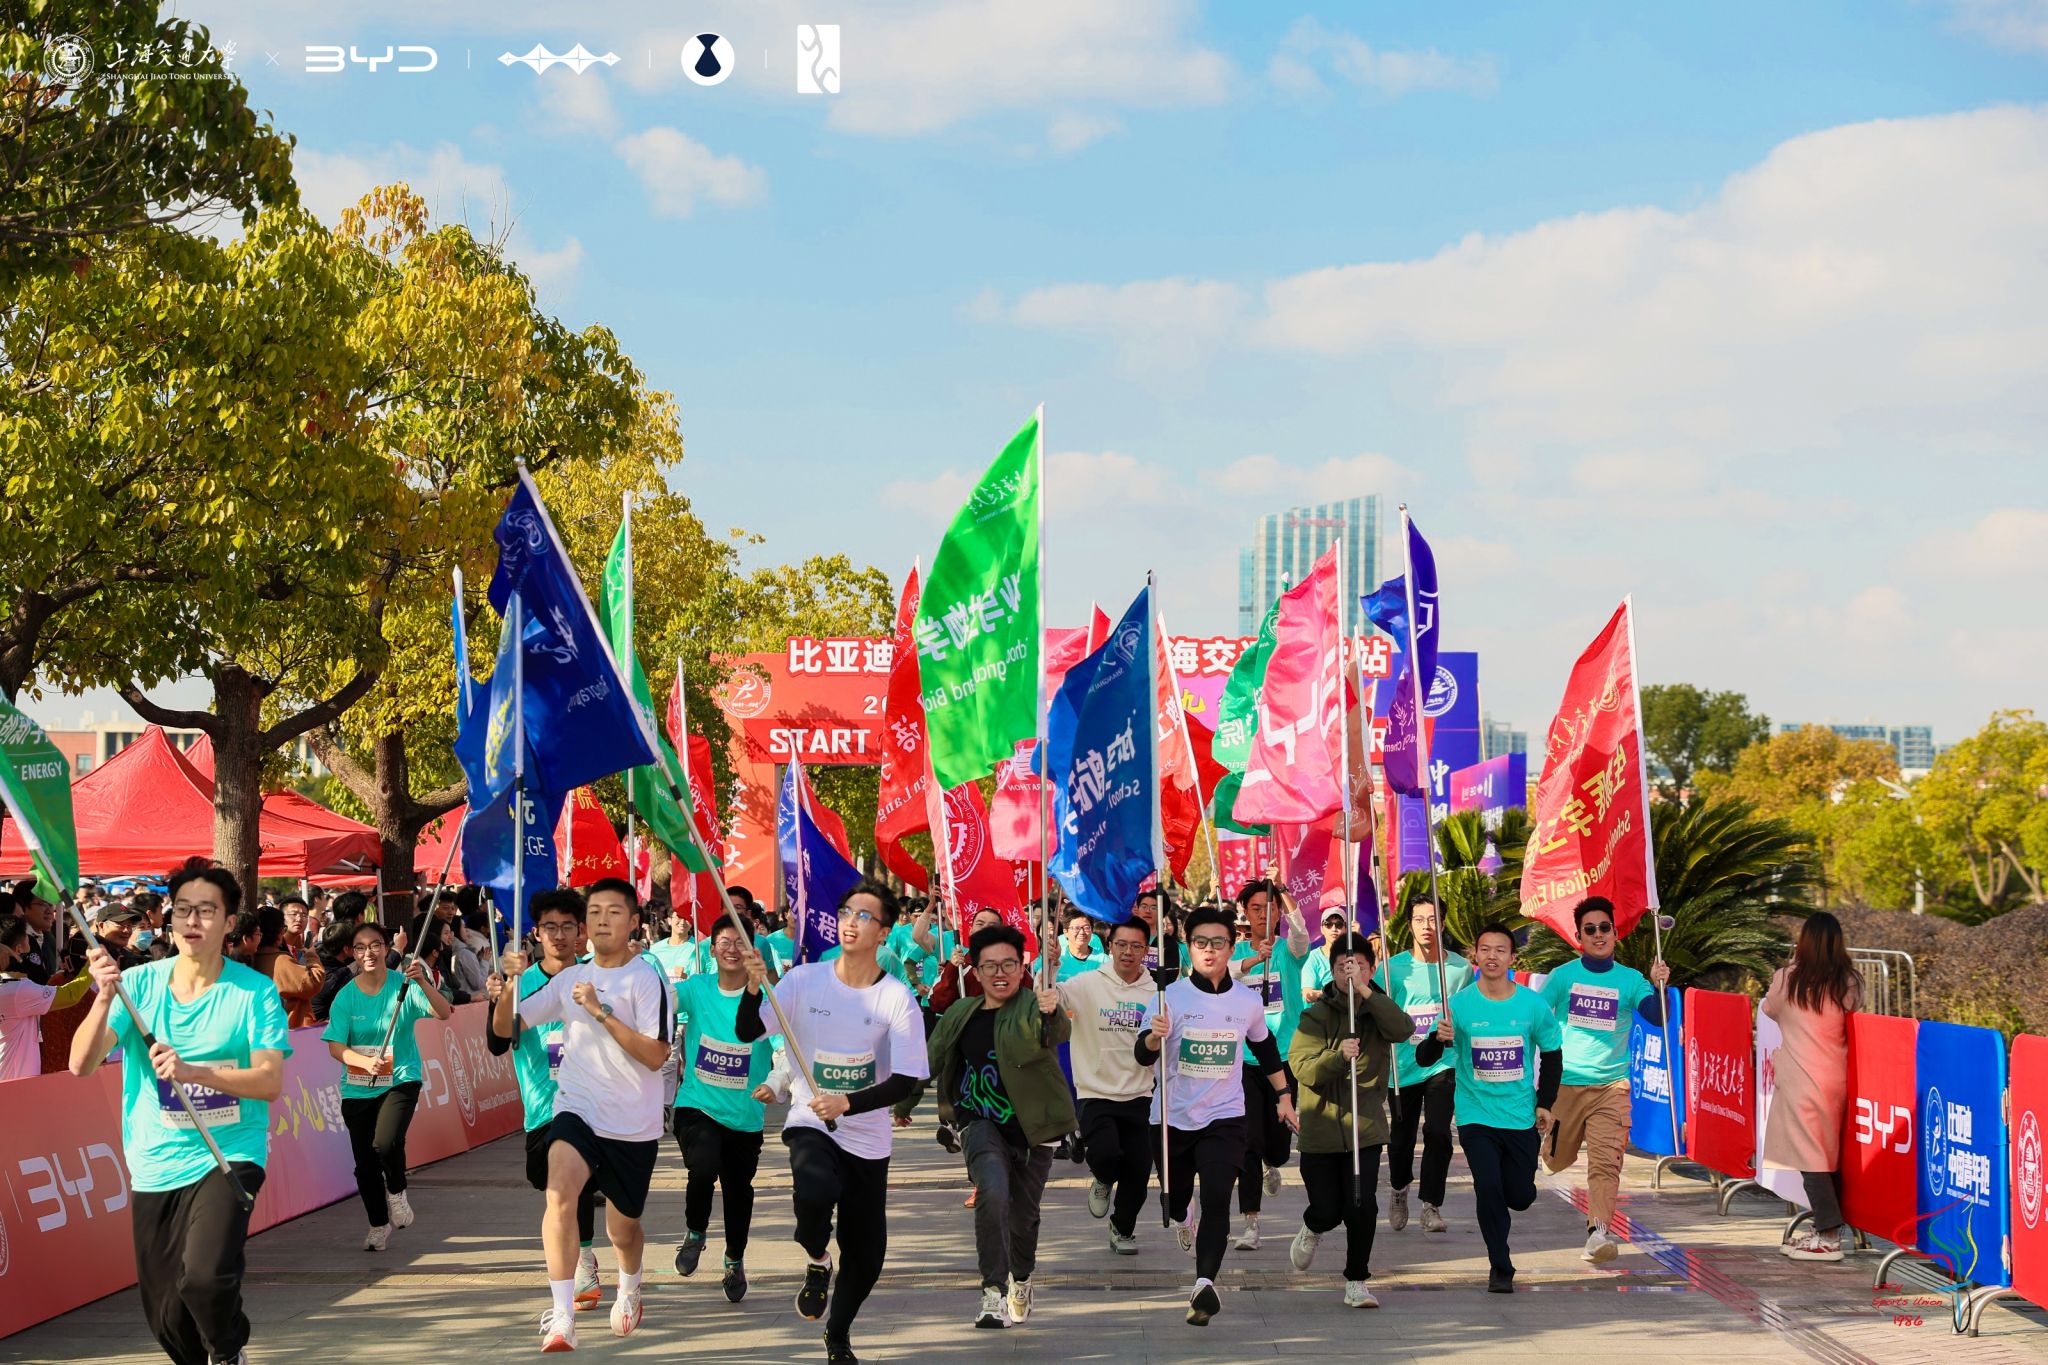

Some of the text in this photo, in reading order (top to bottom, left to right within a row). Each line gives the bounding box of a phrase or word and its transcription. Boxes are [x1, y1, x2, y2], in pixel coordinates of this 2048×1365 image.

[789, 639, 893, 674] 比亚迪
[1170, 640, 1255, 674] 海交
[769, 728, 871, 754] START
[21, 761, 62, 781] ENERGY
[1117, 1001, 1135, 1011] THE
[1576, 997, 1610, 1011] A0118
[1100, 1008, 1135, 1020] NORTH
[1415, 1014, 1437, 1027] A01
[1109, 1018, 1134, 1028] FACE
[1190, 1043, 1228, 1056] C0345
[1479, 1050, 1516, 1062] A0378
[704, 1051, 743, 1068] A0919
[822, 1067, 868, 1080] C0466
[170, 1082, 224, 1098] A026
[1855, 1097, 1912, 1154] BYD
[1947, 1101, 1972, 1146] 比亚迪
[1948, 1146, 1990, 1204] 中国青年跑
[18, 1142, 128, 1233] BYD
